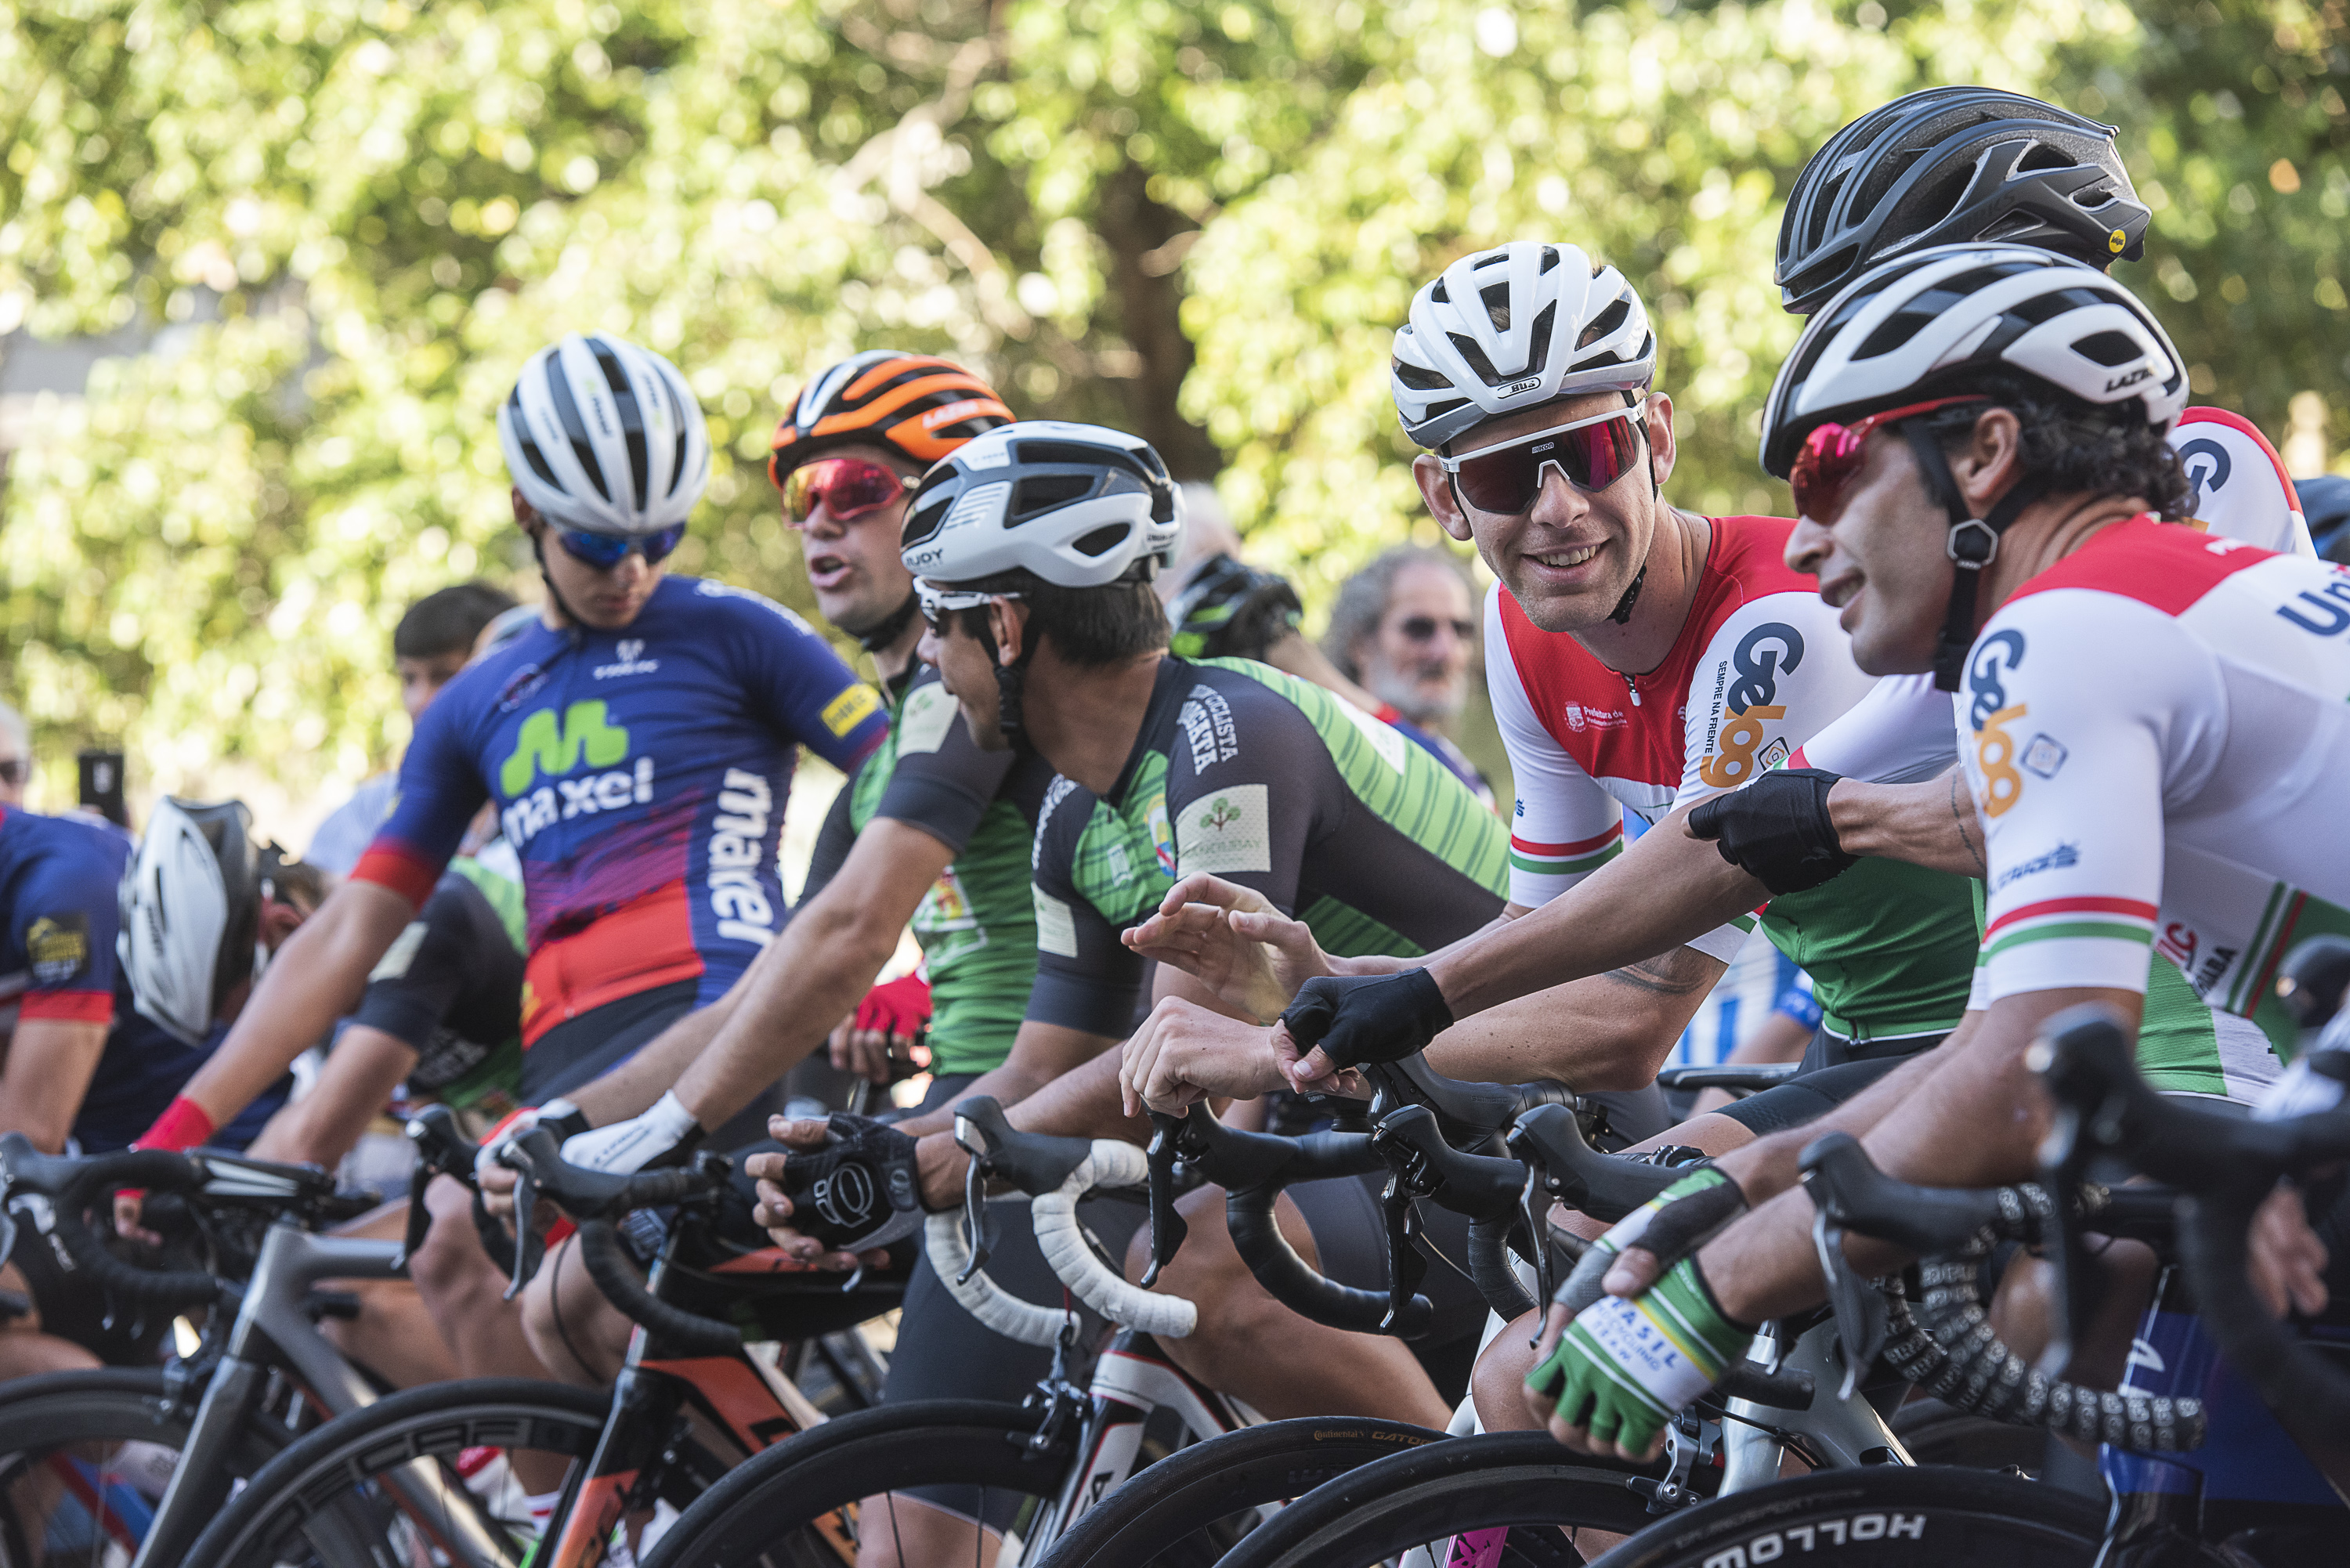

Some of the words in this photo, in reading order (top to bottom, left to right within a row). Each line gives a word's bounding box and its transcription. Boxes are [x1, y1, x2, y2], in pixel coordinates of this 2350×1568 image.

[1509, 380, 1536, 394] BUS
[1713, 660, 1727, 700] SEMPRE
[1700, 622, 1804, 788] Gelog
[1712, 702, 1723, 715] NA
[1583, 706, 1612, 719] Prefeitura
[1612, 710, 1624, 718] de
[1705, 716, 1719, 754] FRENTE
[1314, 1429, 1358, 1441] Continental
